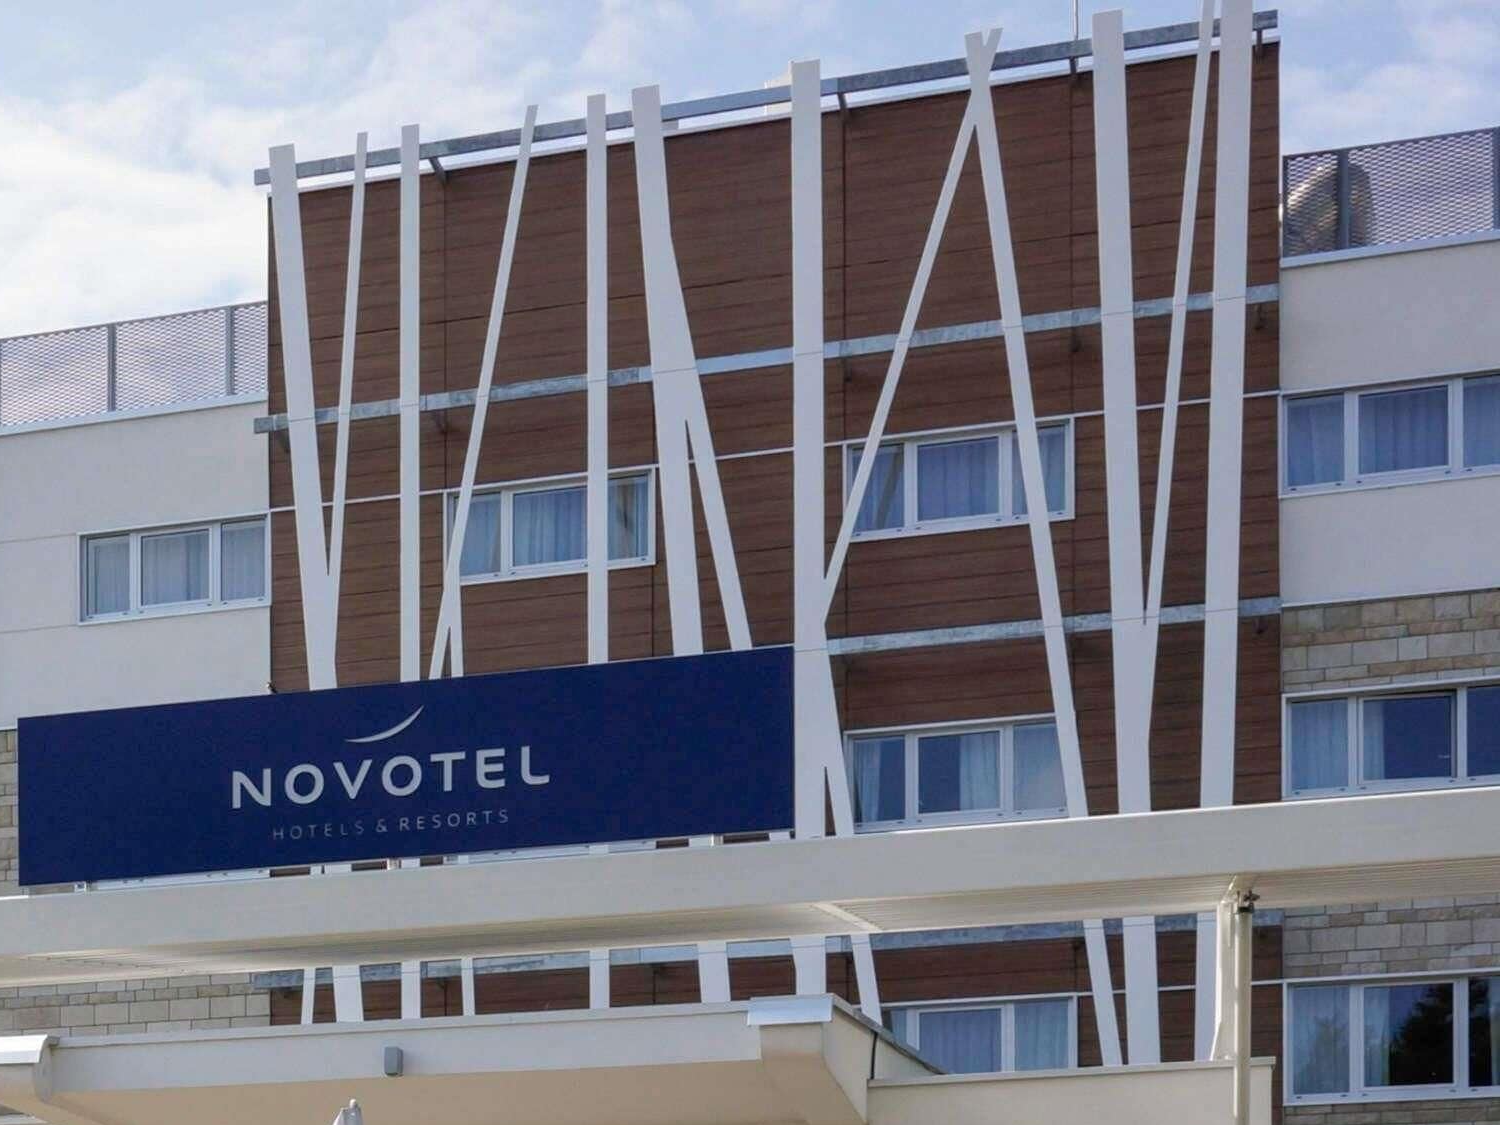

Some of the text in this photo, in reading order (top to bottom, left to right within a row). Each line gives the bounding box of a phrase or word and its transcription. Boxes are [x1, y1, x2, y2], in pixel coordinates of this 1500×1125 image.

[231, 745, 551, 809] NOVOTEL
[272, 808, 509, 841] HOTELS & RESORTS
